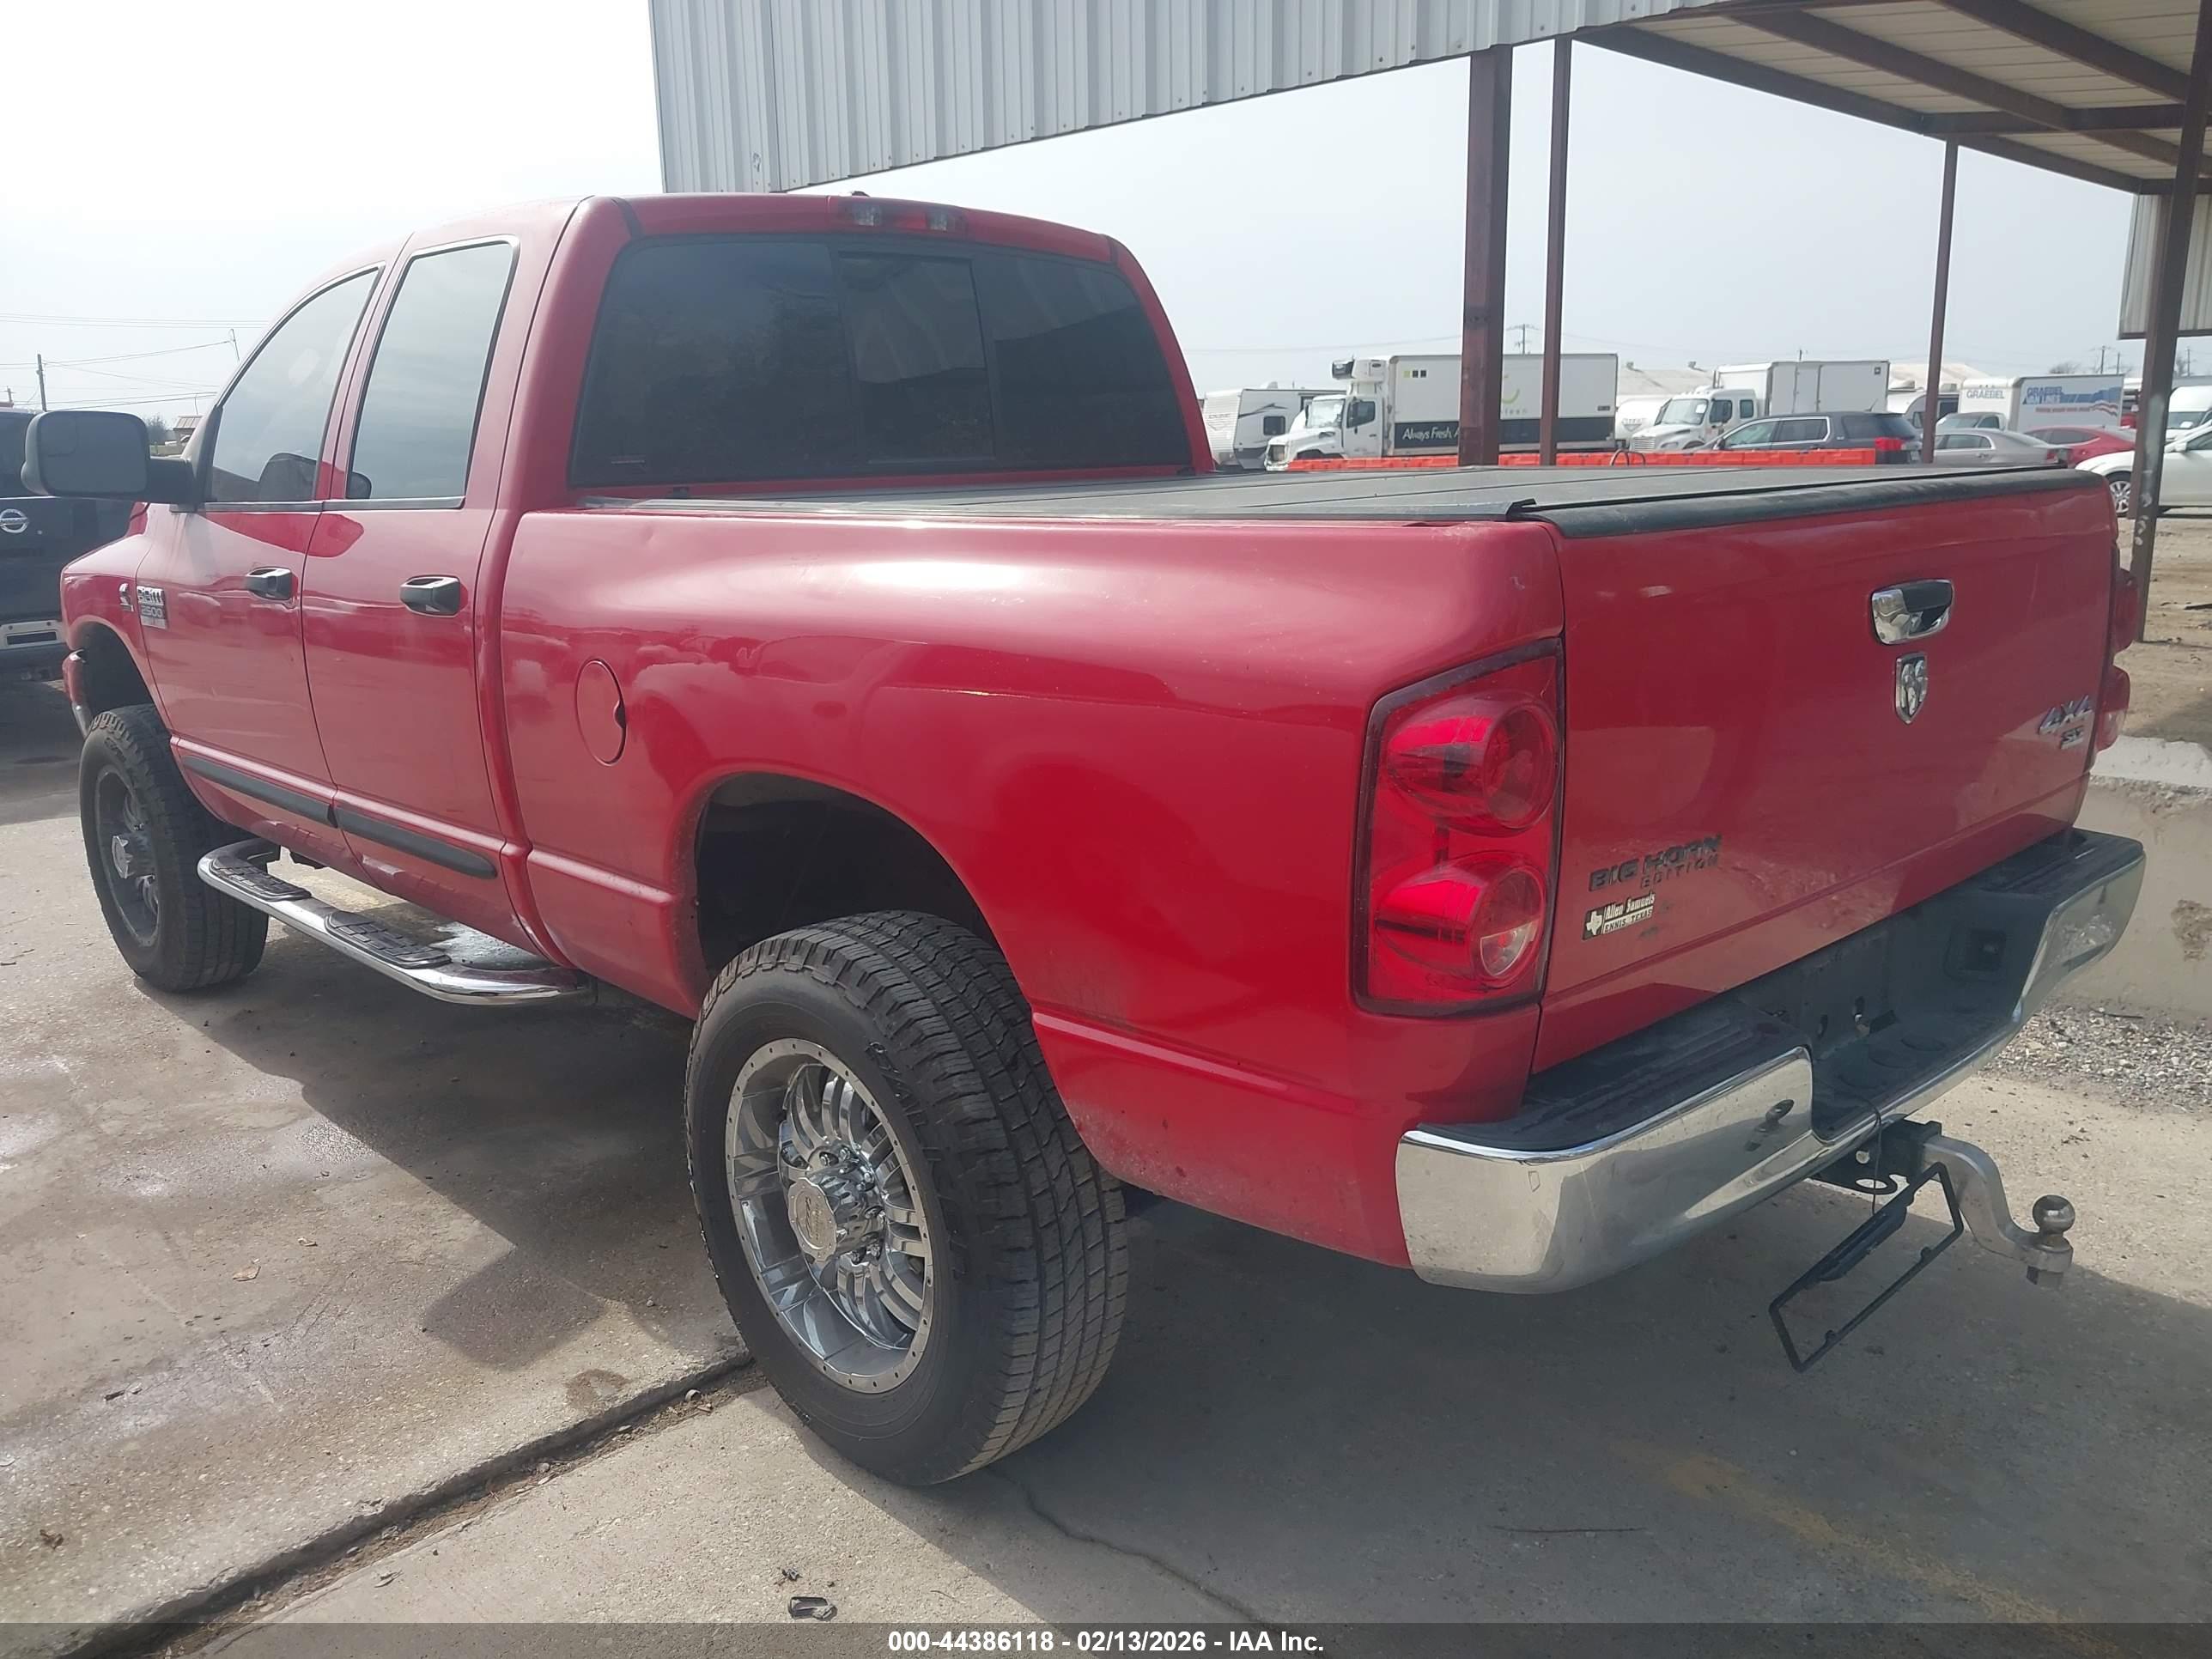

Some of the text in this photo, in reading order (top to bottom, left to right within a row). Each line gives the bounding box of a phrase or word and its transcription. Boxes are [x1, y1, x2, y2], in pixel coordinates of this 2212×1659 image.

[1589, 835, 1722, 891] BIG HORN
[1640, 854, 1719, 889] EDITION
[1604, 906, 1653, 933] ENNIS TEXAS
[1605, 891, 1656, 921] Allen Samuels
